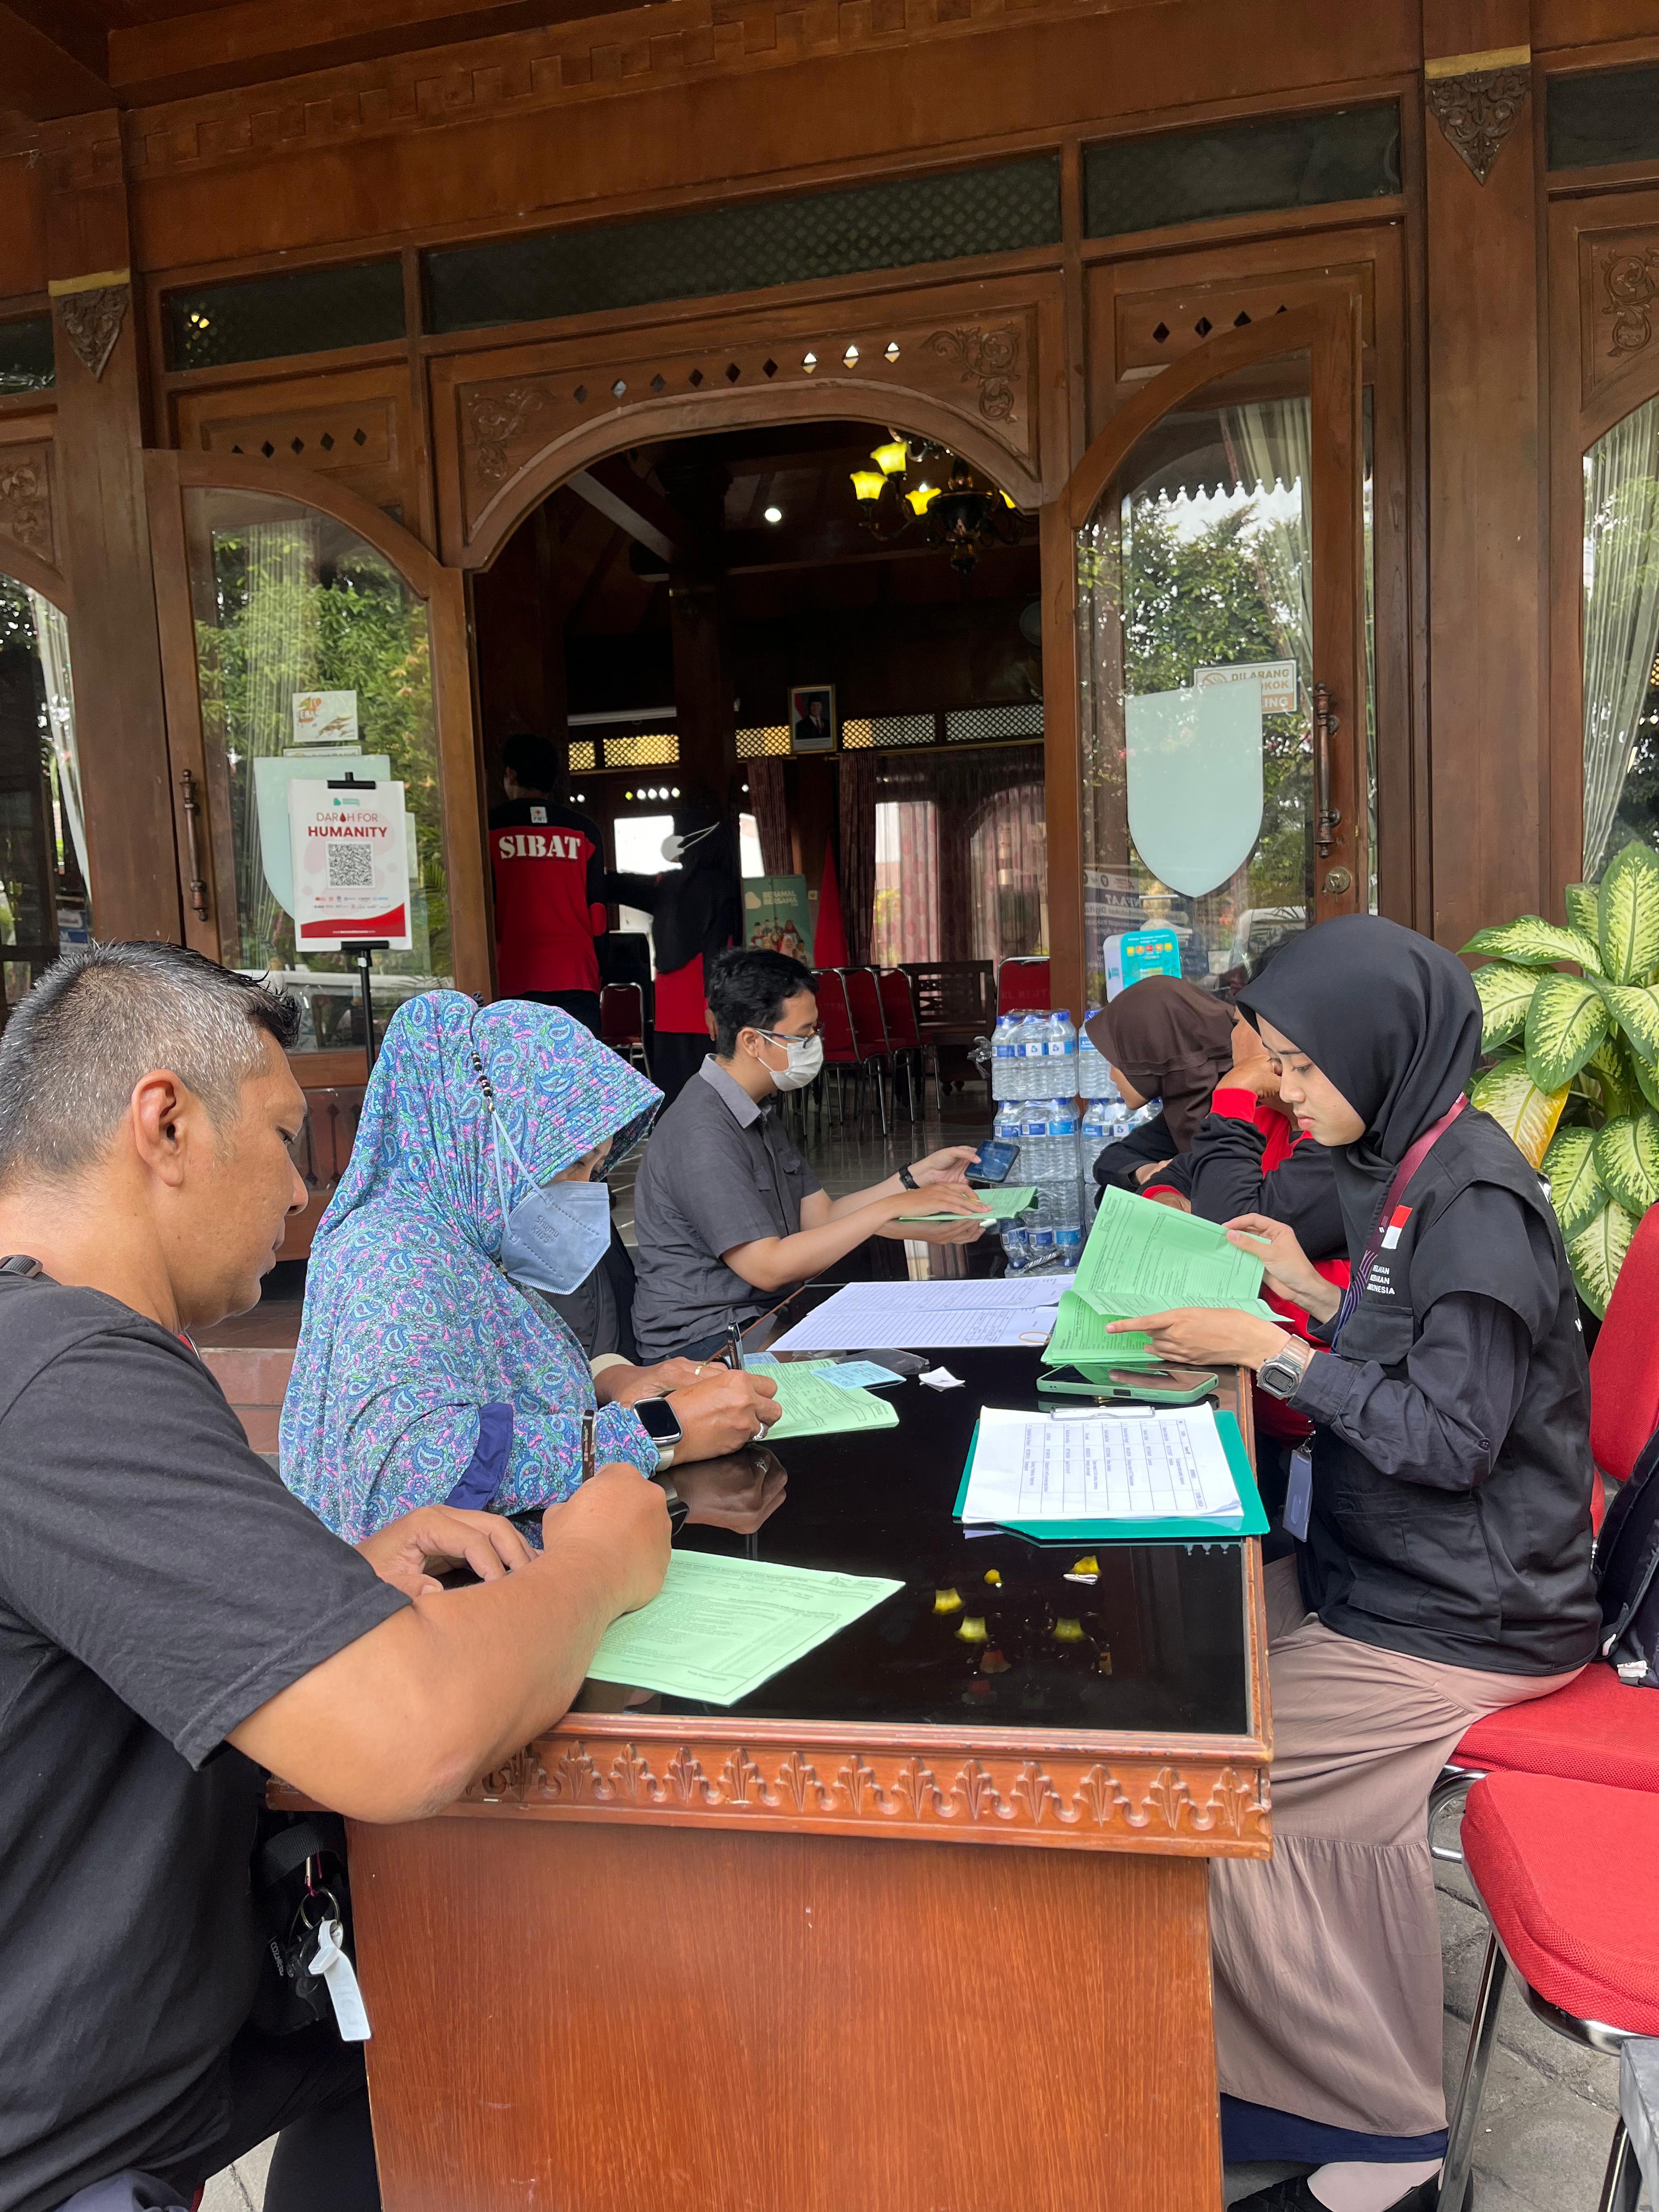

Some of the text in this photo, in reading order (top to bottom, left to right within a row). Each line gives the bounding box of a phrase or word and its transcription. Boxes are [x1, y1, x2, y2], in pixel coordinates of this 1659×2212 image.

[358, 813, 378, 822] FOR
[308, 826, 387, 837] HUMANITY
[499, 834, 581, 860] SIBAT
